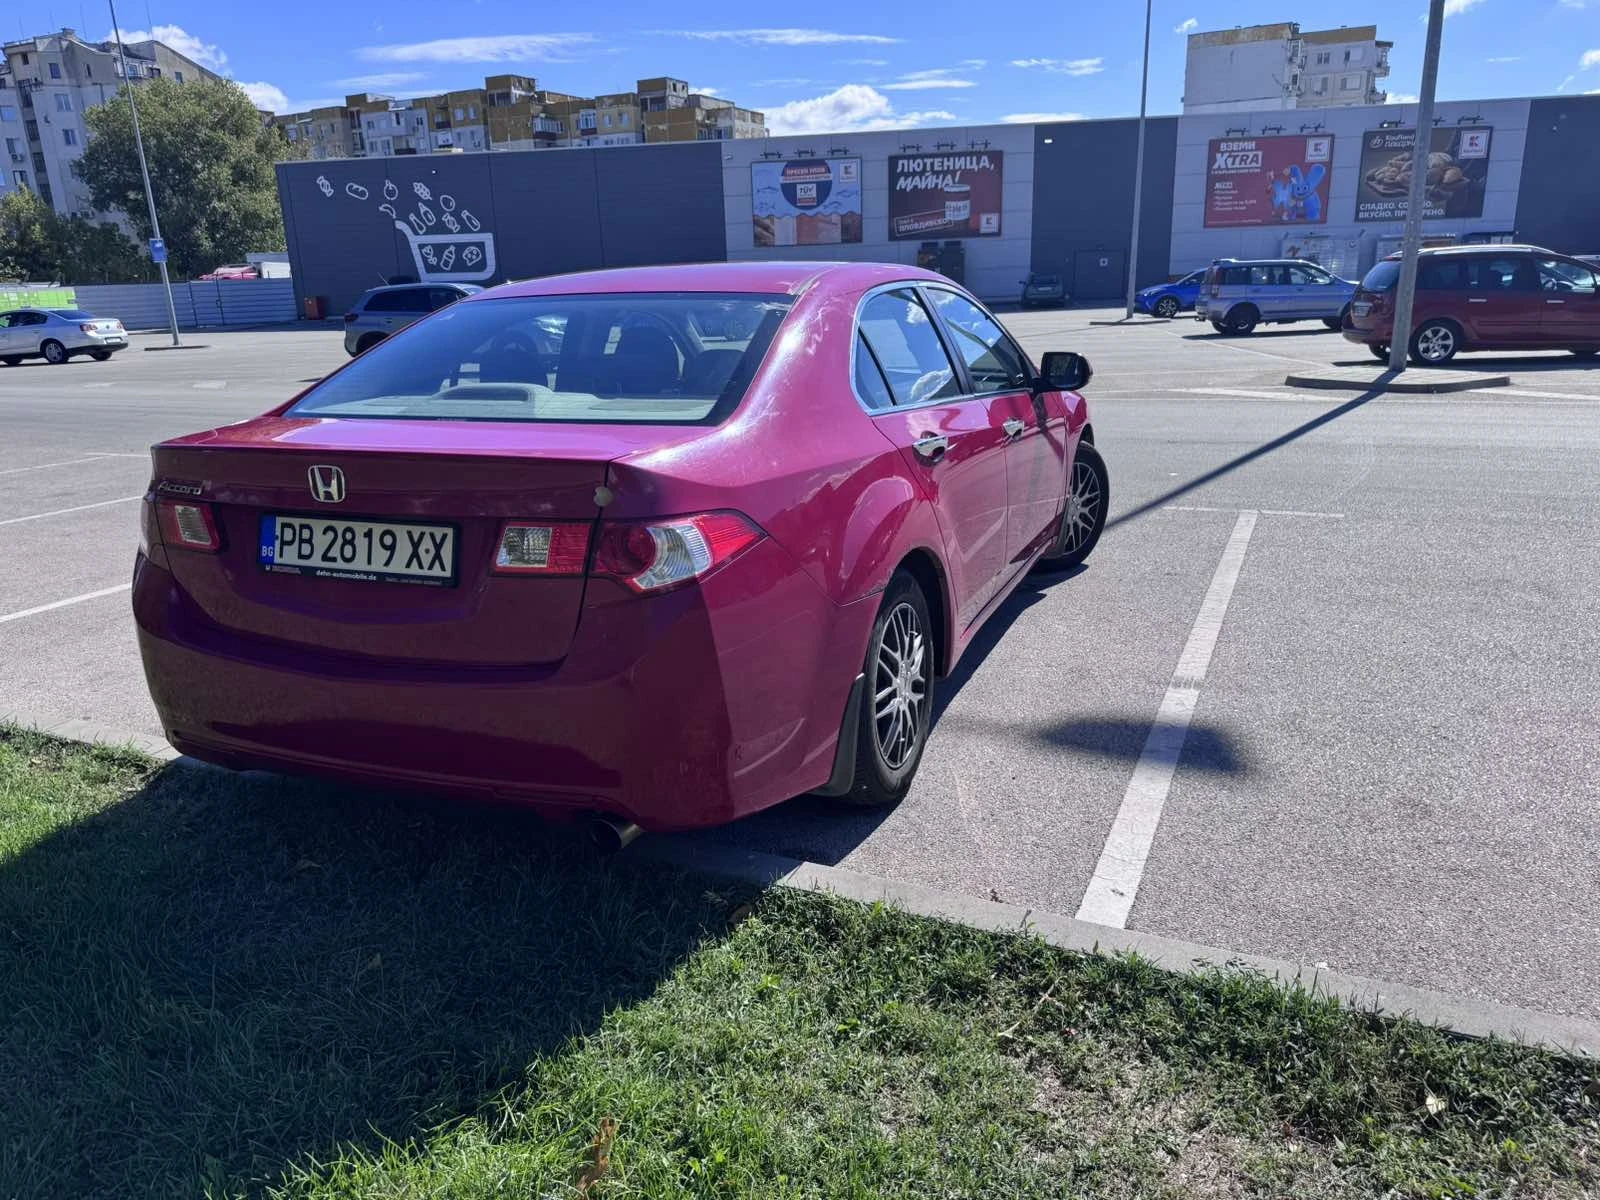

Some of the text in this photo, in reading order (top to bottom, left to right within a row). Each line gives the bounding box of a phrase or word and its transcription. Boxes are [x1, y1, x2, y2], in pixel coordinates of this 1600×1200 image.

[896, 155, 994, 173] ЛЮТЕНИЦА,
[896, 170, 961, 192] МАЙНА!
[261, 545, 274, 557] BG
